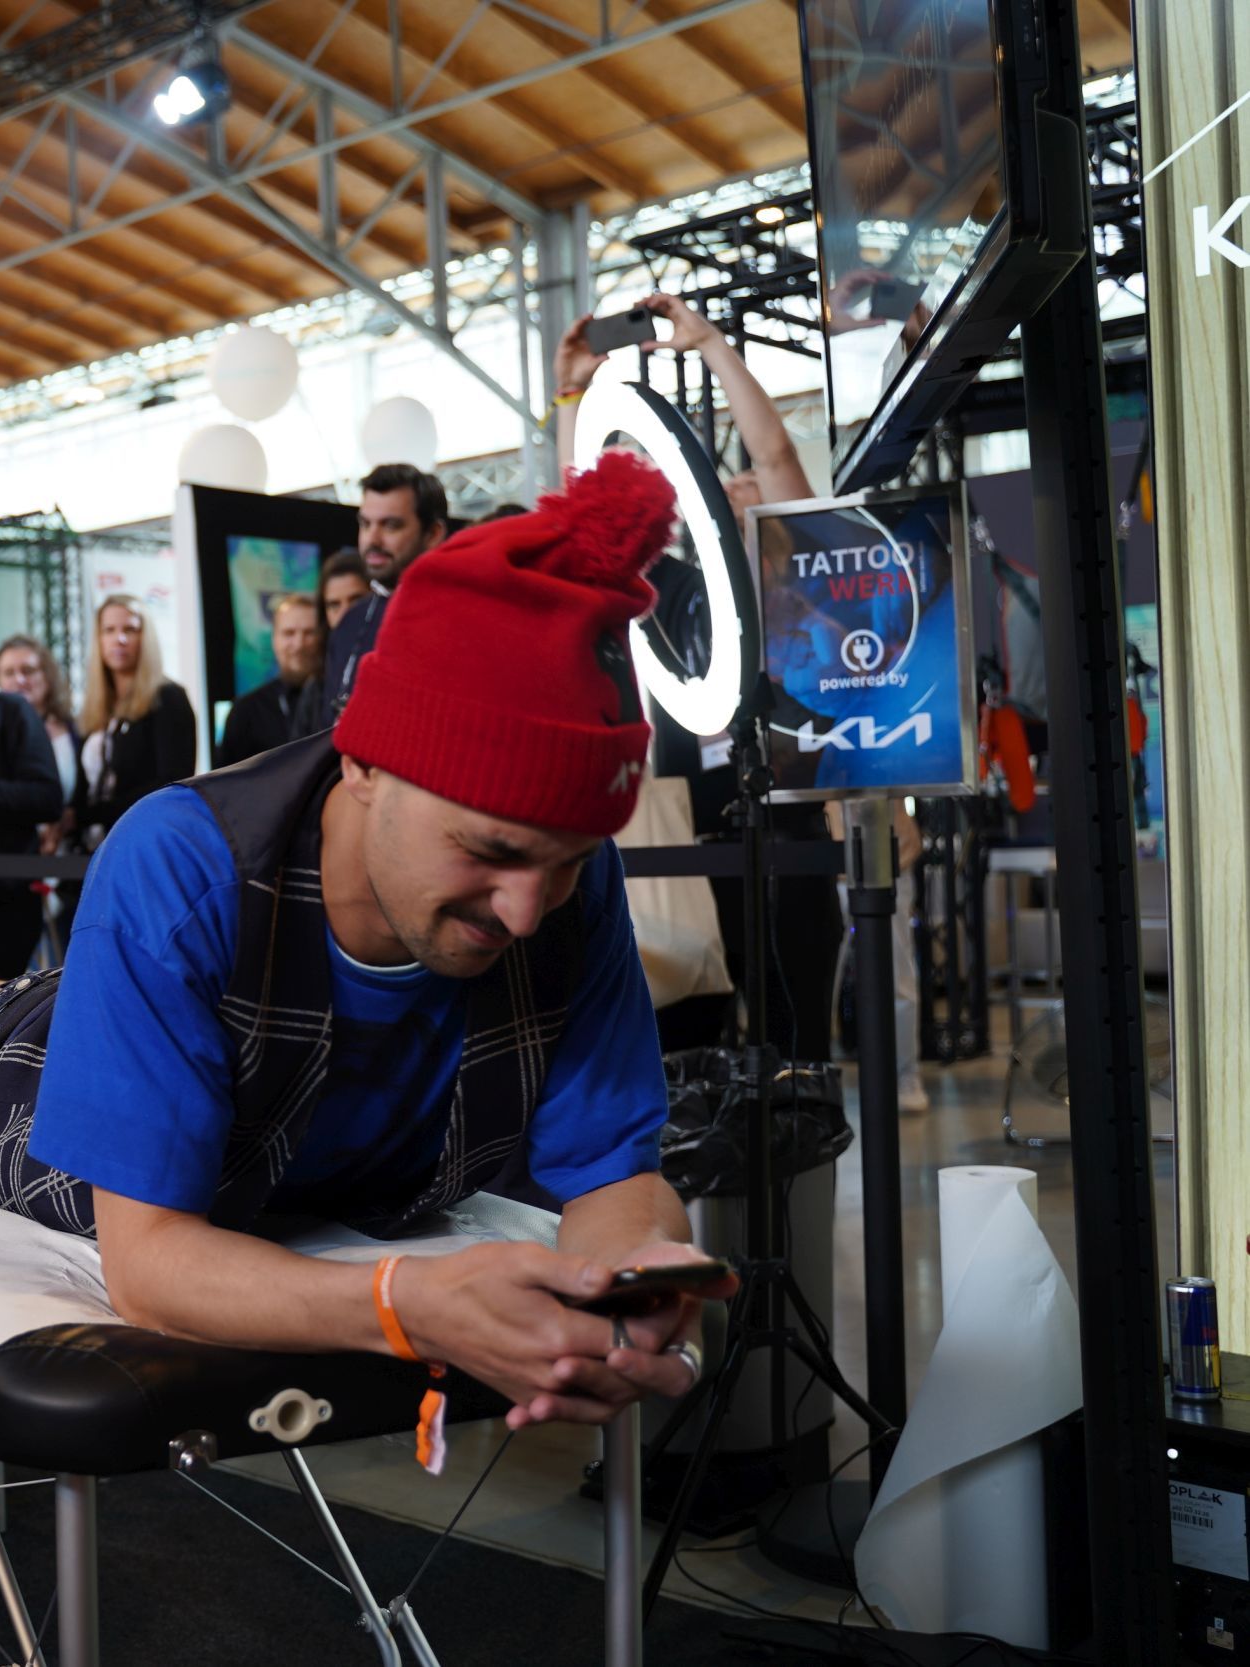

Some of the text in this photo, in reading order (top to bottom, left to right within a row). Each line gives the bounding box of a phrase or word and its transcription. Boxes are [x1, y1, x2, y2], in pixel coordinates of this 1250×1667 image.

[792, 542, 915, 578] TATTOO
[828, 569, 916, 602] WERK
[819, 671, 910, 693] powered by
